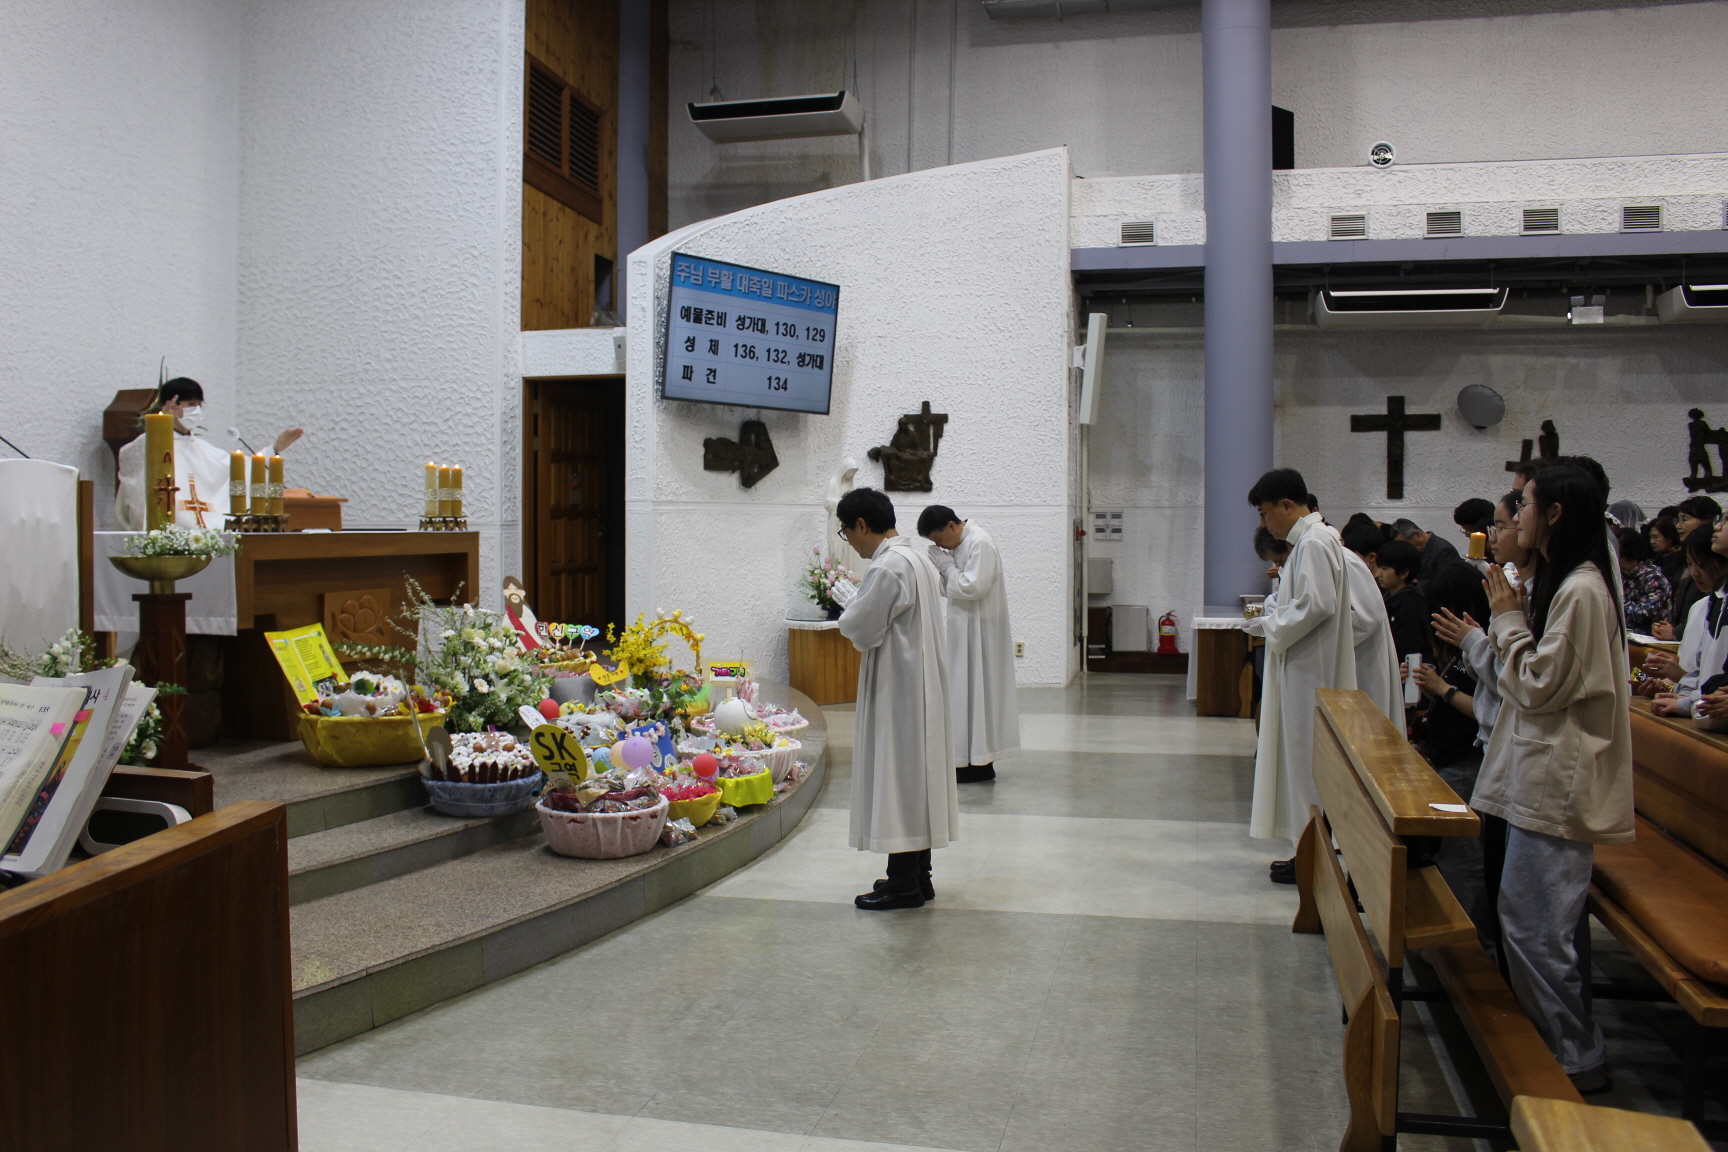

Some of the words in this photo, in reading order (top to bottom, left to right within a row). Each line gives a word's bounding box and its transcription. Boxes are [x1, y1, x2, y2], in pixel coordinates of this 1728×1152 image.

[676, 261, 703, 285] 주님
[708, 267, 733, 290] 부활
[736, 273, 773, 298] 대축일
[776, 280, 811, 305] 파스카
[814, 288, 837, 309] 성야
[680, 305, 727, 328] 예물준비
[735, 314, 769, 335] 성가대,
[775, 321, 799, 340] 130,
[806, 326, 826, 342] 129
[733, 343, 759, 361] 136,
[766, 347, 790, 366] 132,
[796, 351, 825, 370] 성가대
[767, 375, 788, 392] 134
[537, 623, 595, 640] 한신구역
[535, 731, 577, 761] SK
